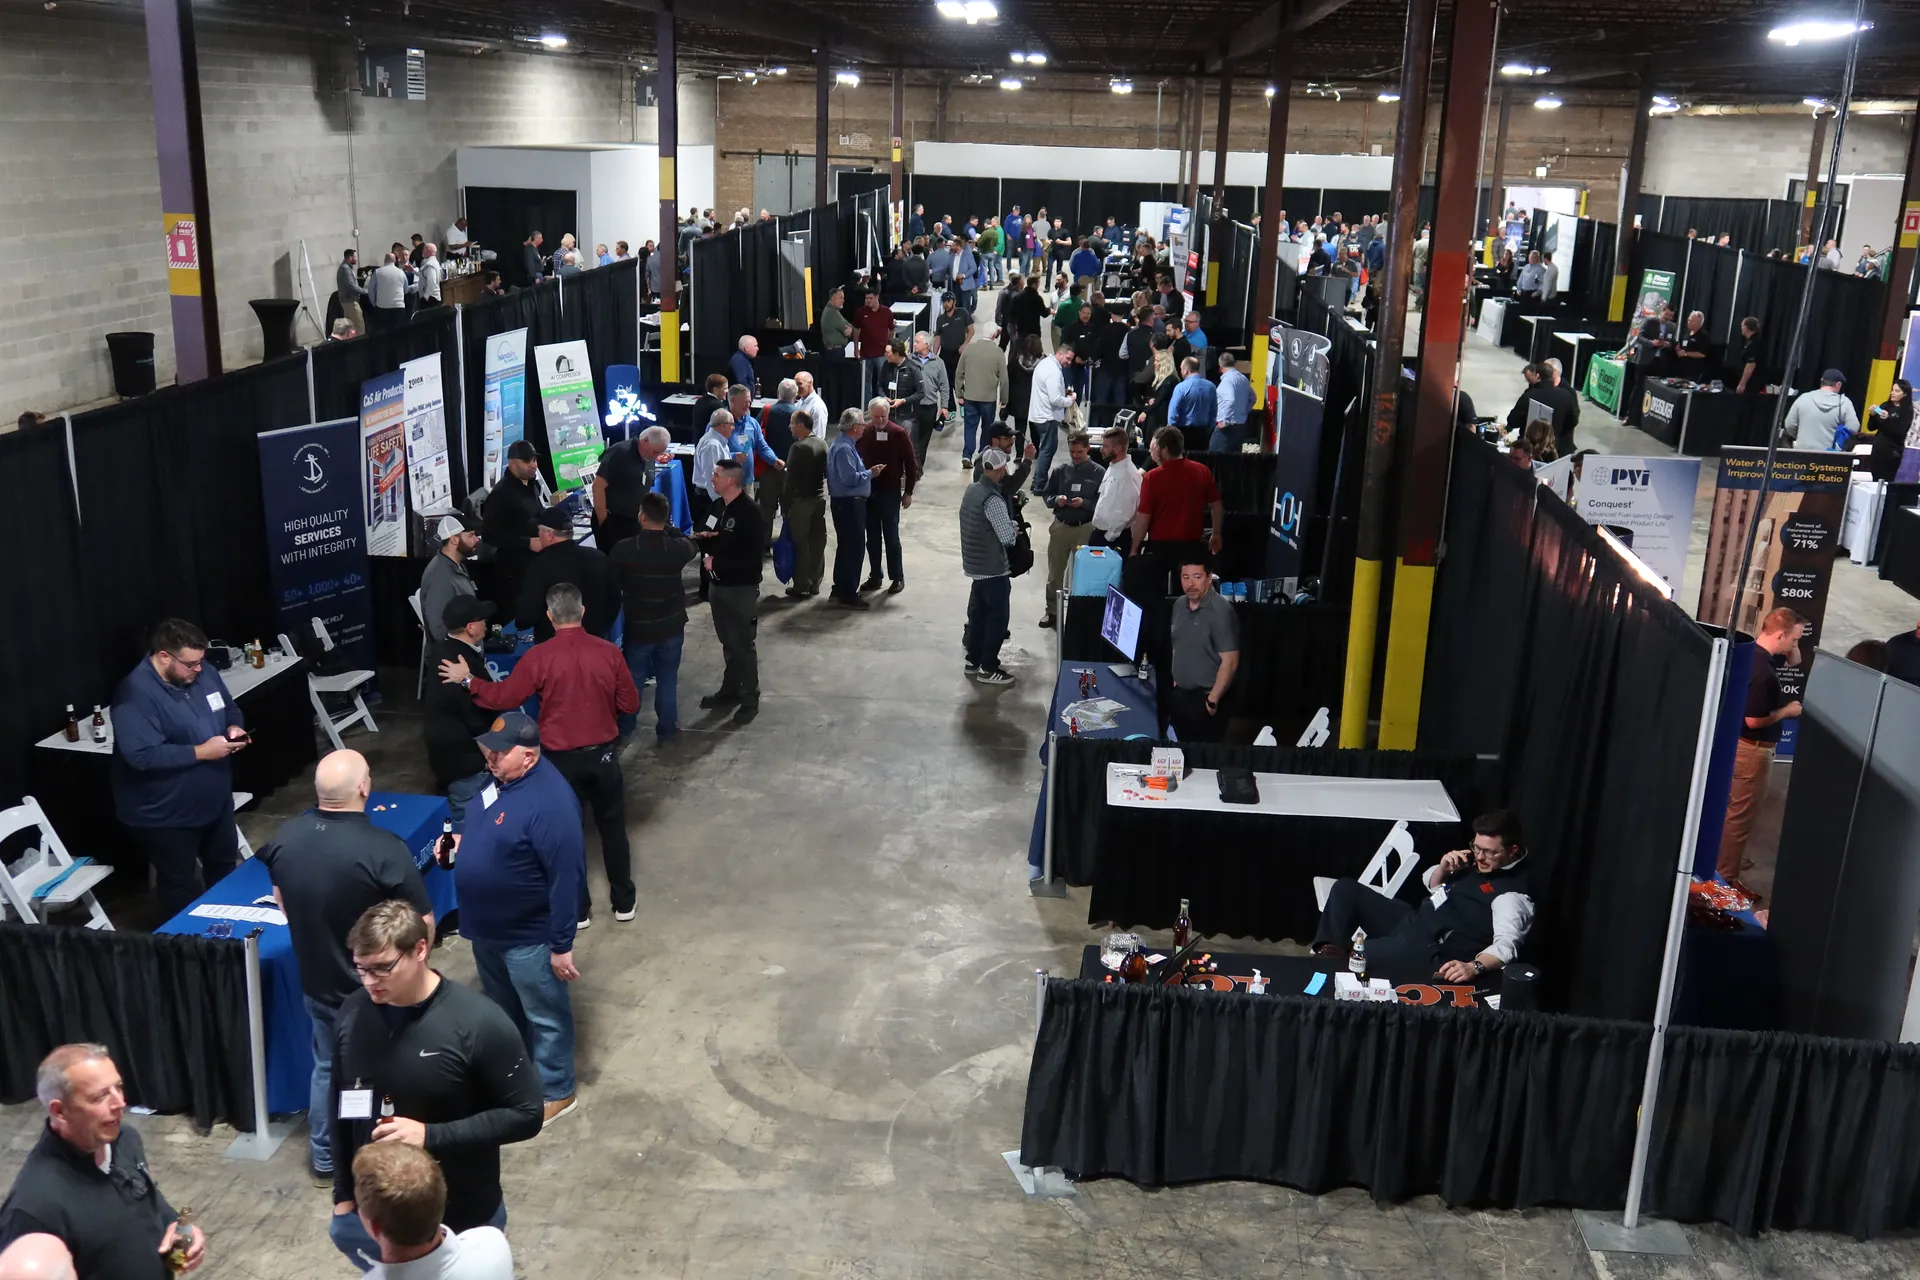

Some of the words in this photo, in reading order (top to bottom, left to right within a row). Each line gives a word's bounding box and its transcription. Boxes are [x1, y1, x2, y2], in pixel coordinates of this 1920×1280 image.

[1725, 458, 1755, 467] Water
[1757, 459, 1807, 470] Prtection
[1809, 462, 1849, 473] Systems
[1727, 469, 1765, 479] Improv
[1771, 471, 1791, 480] Your
[1794, 473, 1816, 481] Loss
[1819, 474, 1843, 483] Ratio
[284, 518, 308, 532] HIGH
[309, 508, 349, 528] QUALITY
[294, 526, 341, 545] SERVICES
[280, 549, 307, 565] WITH
[308, 537, 357, 559] INTEGRITY
[1793, 539, 1818, 549] 71%
[1781, 587, 1814, 598] $80K
[330, 613, 344, 623] HELP
